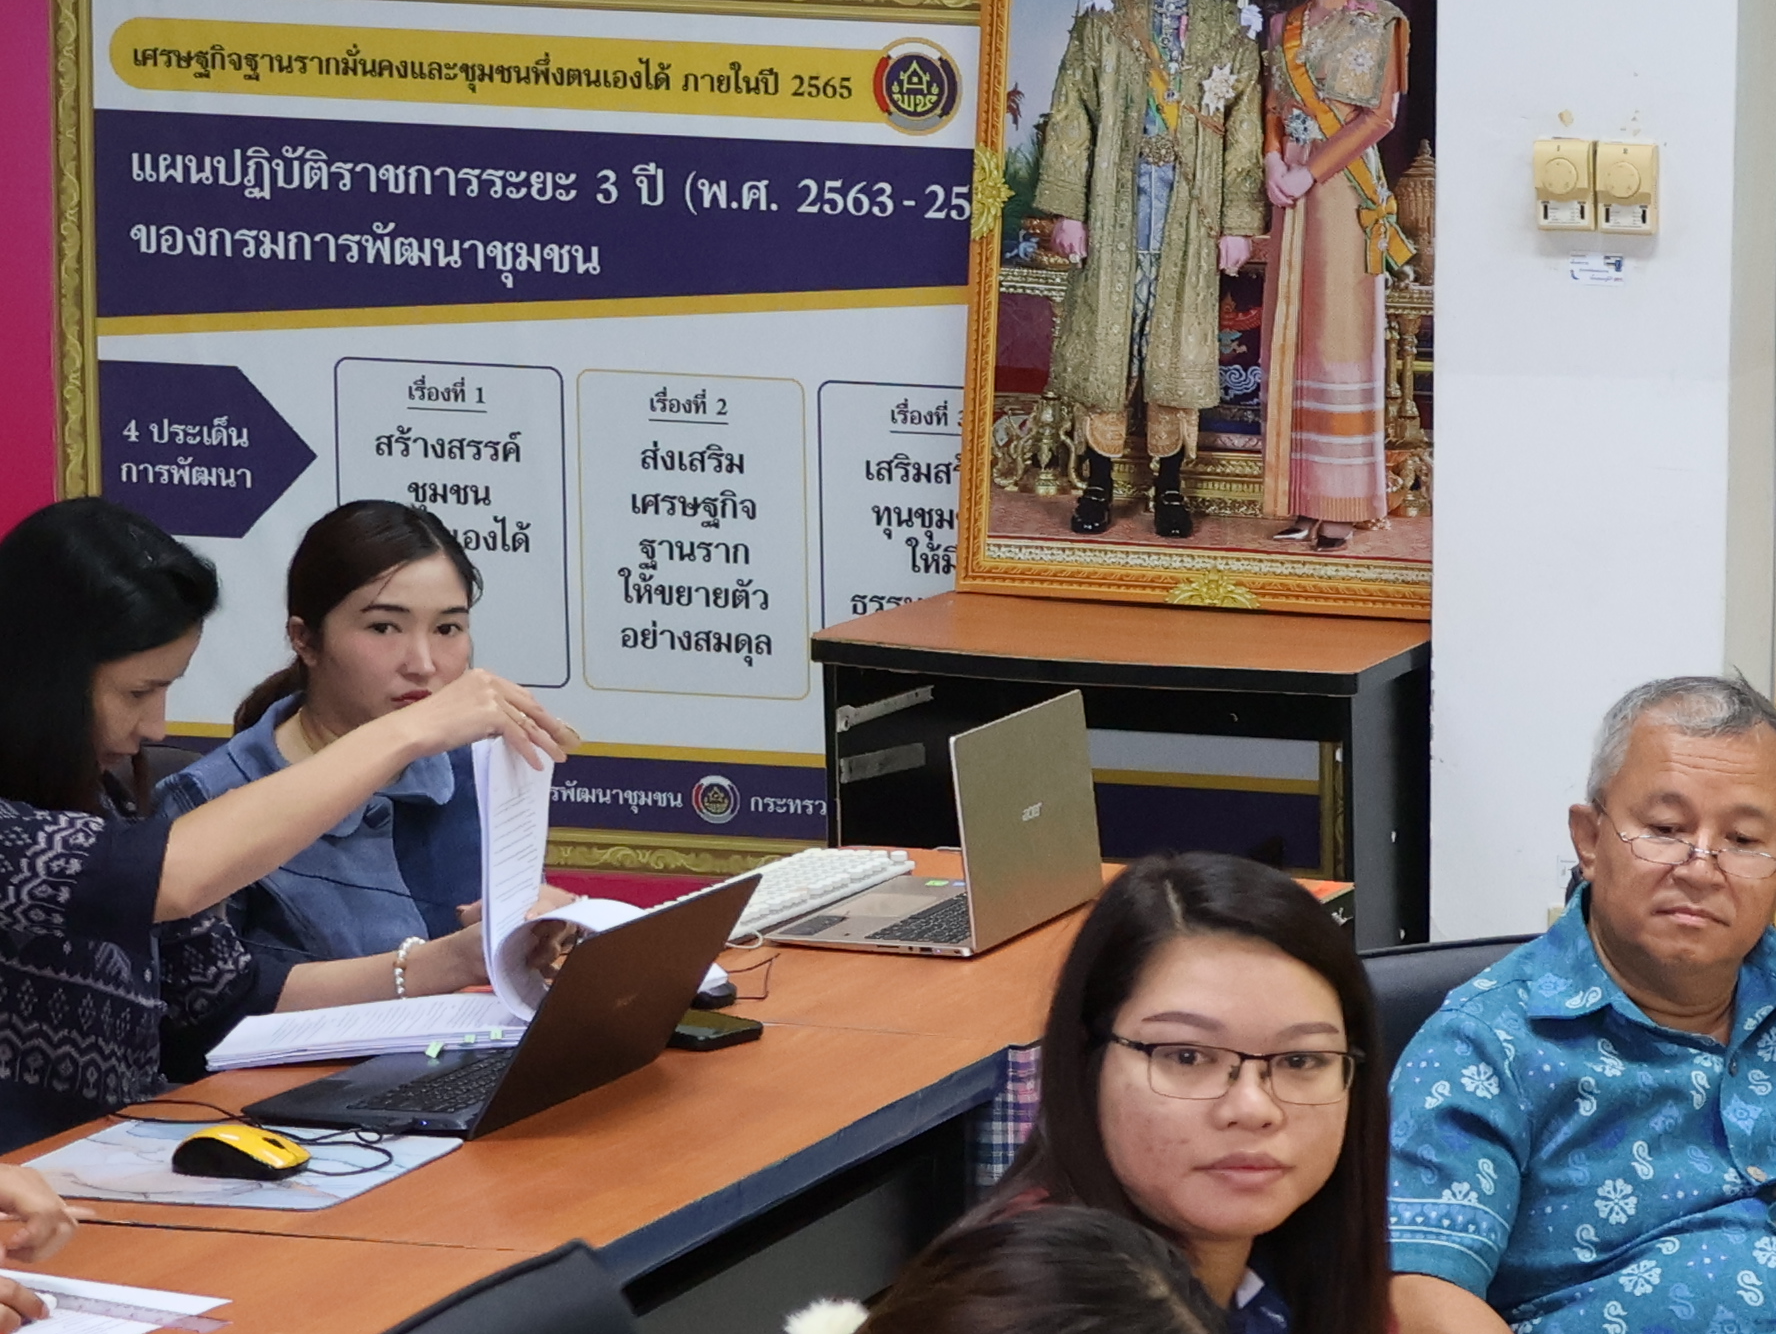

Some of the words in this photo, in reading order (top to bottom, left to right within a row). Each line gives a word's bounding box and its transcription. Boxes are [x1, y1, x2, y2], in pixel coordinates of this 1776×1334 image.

[132, 43, 672, 93] เศรษฐกิจฐานรากมั่นคงและชุมชนพึ่งตนเองได้
[681, 61, 780, 96] ภายในปี
[790, 73, 853, 100] 2565
[131, 145, 578, 201] แผนปฏิบัติราชการระยะ
[595, 168, 619, 205] 3
[631, 161, 665, 206] ปี
[683, 170, 779, 216] (พ.ศ.
[129, 220, 601, 288] ของกรมการพัฒนาชุมชน
[407, 378, 468, 406] เรื่องที่
[474, 384, 487, 405] 1
[649, 386, 707, 415] เรื่องที่
[716, 397, 728, 416] 2
[890, 398, 949, 427] เรื่องที่
[121, 419, 140, 443] 4
[148, 415, 250, 448] ประเด็น
[374, 426, 523, 463] สร้างสรรค์
[119, 455, 253, 489] การพัฒนา
[640, 440, 745, 475] ส่งเสริม
[406, 479, 492, 512] ชุมชน
[631, 489, 757, 529] เศรษฐกิจ
[638, 538, 750, 571] ฐานราก
[617, 566, 770, 611] ให้ขยายตัว
[620, 620, 772, 667] อย่างสมดุล
[750, 795, 827, 816] กระทรว
